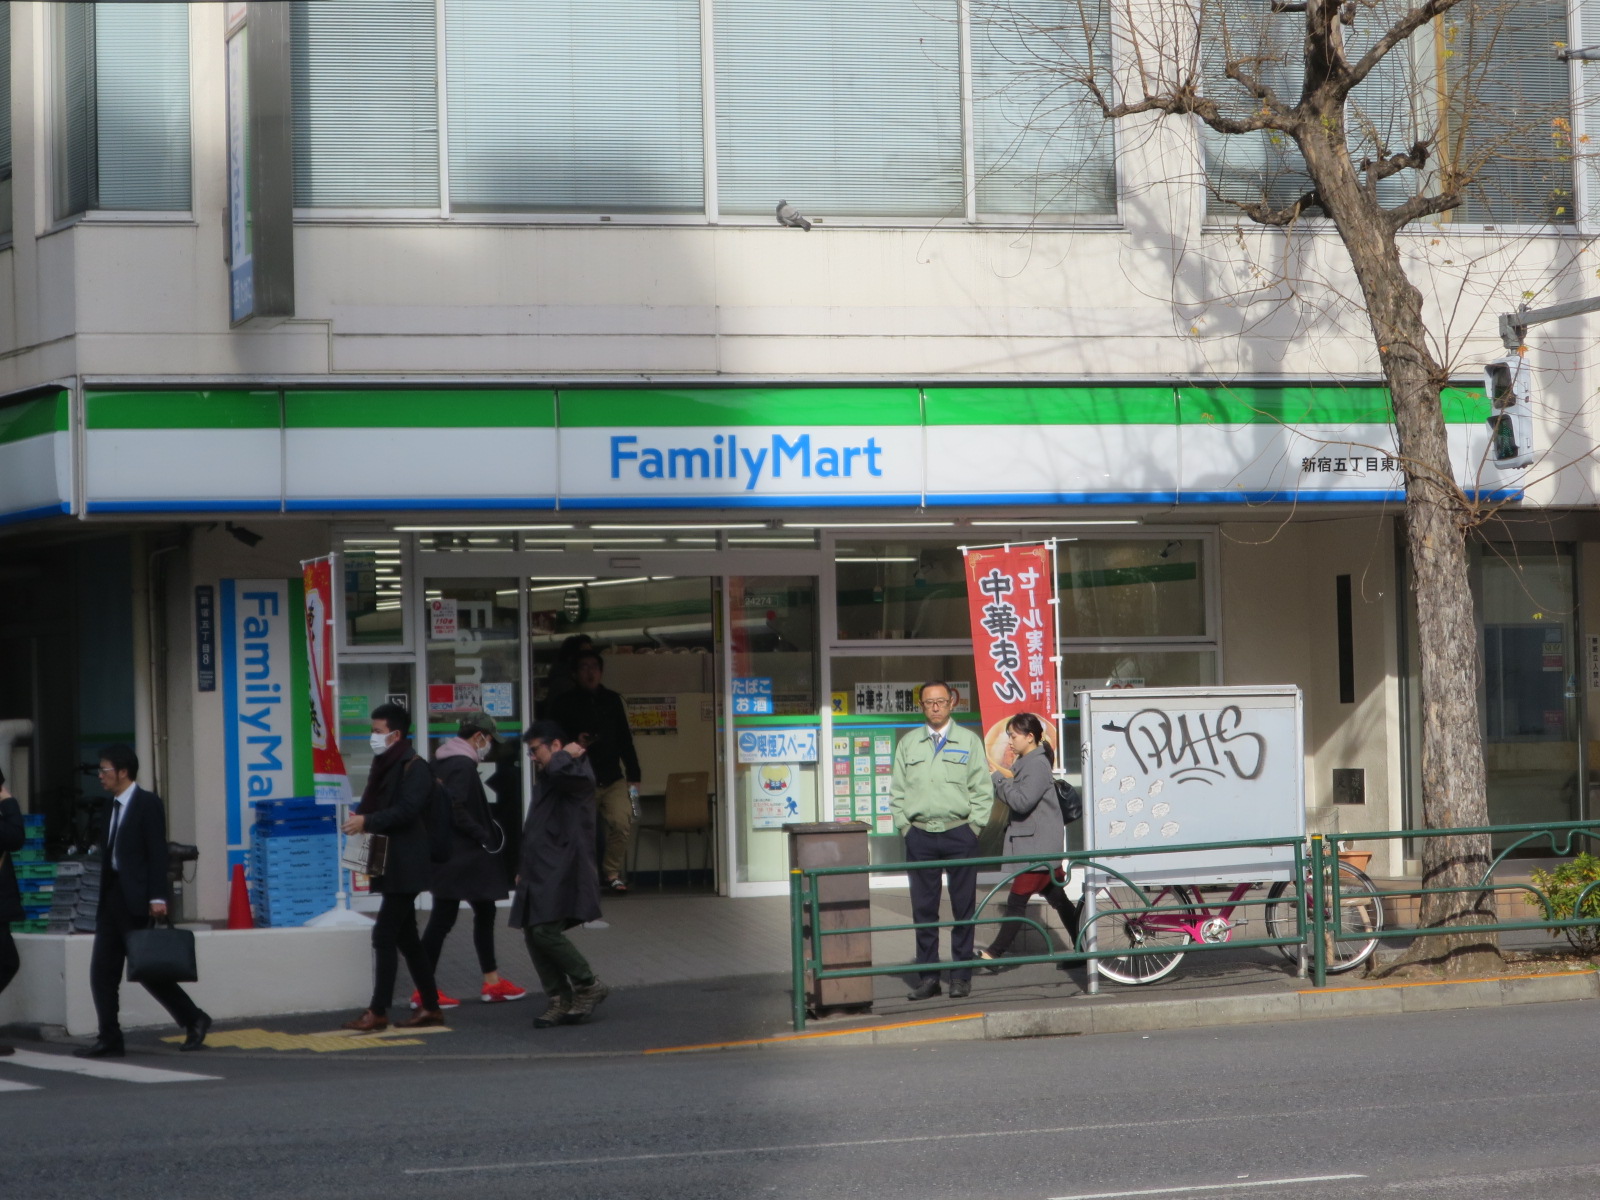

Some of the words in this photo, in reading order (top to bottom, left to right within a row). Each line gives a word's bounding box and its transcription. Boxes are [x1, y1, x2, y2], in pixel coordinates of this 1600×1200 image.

[610, 433, 882, 490] FamilyMart
[732, 679, 771, 694] たばこ
[239, 591, 283, 834] FamilyMa
[736, 697, 767, 712] お酒
[757, 733, 816, 758] 喫煙スペース
